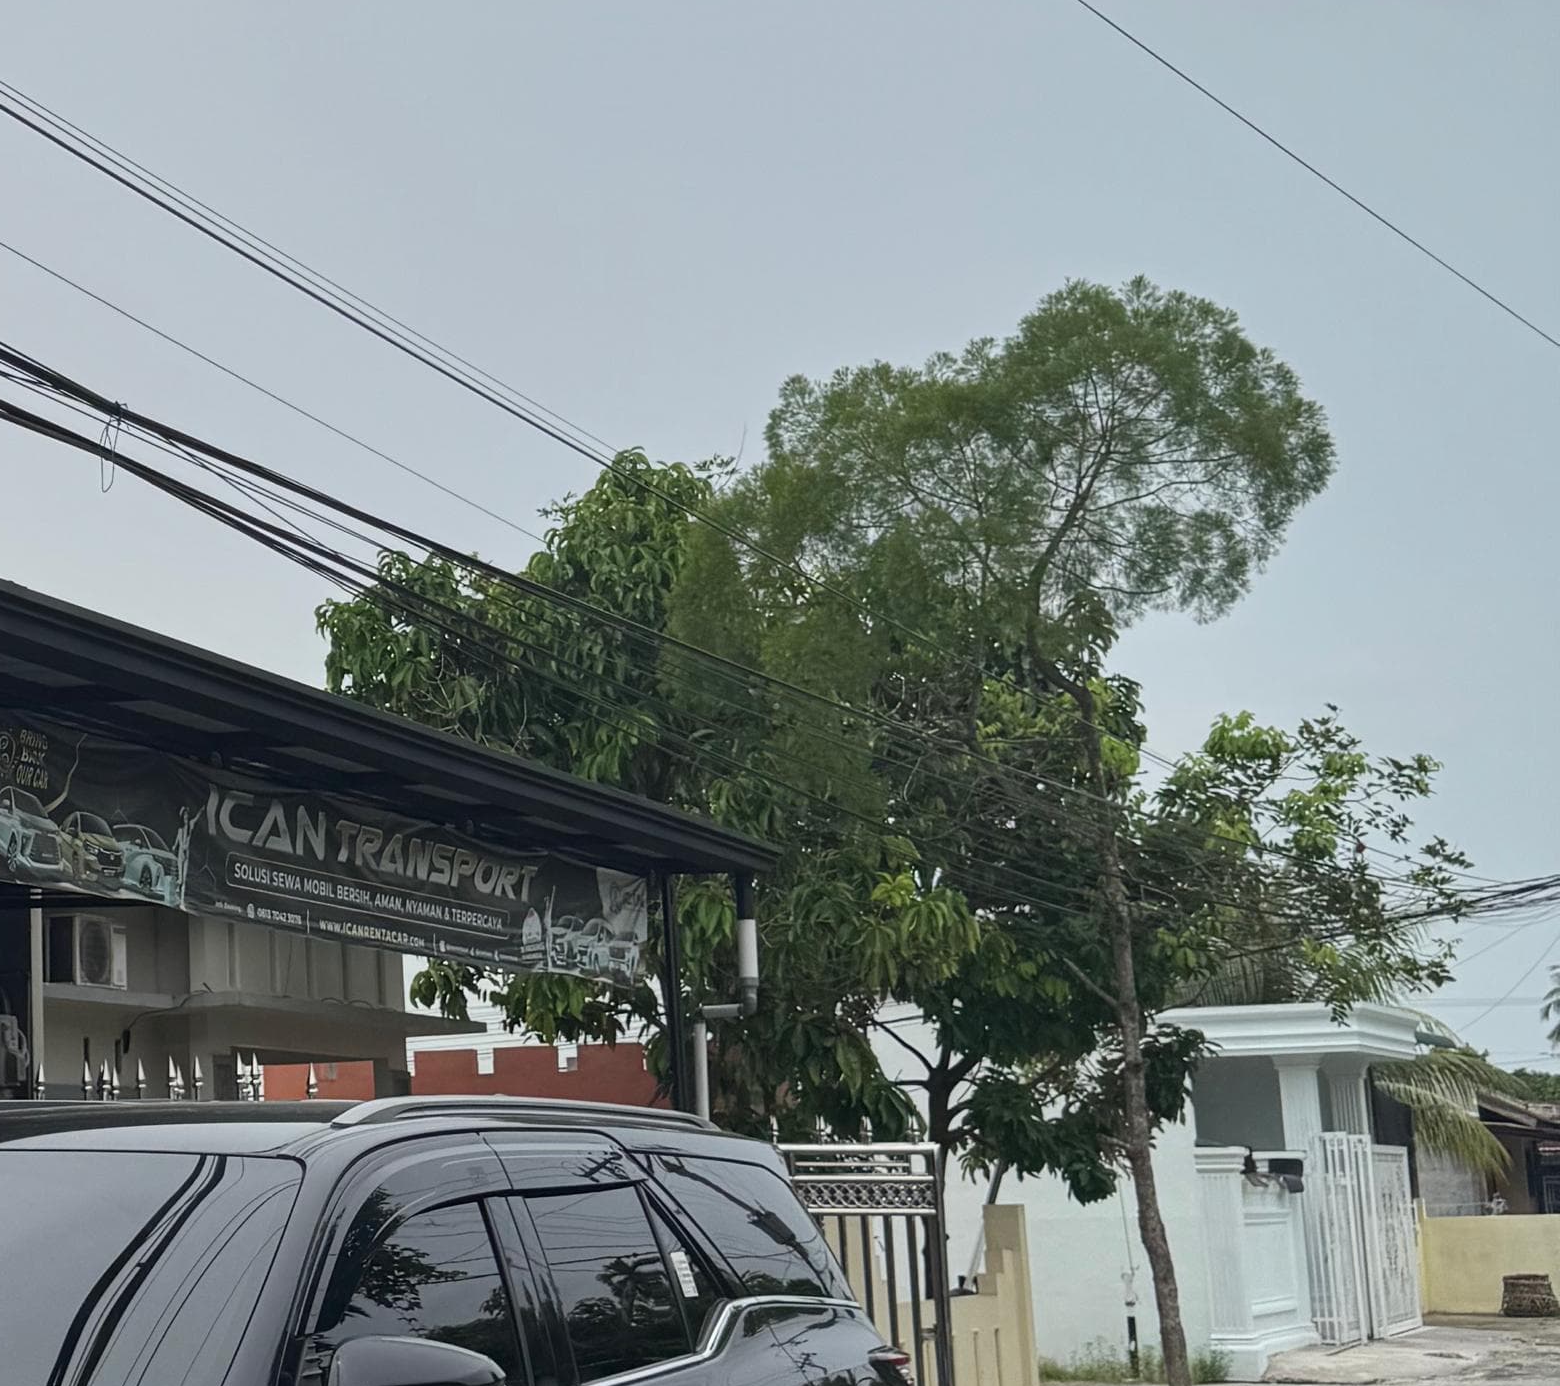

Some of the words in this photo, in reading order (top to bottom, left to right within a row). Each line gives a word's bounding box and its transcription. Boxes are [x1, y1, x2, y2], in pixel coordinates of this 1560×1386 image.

[207, 783, 327, 861] ICAN
[336, 820, 539, 902] TRANSPORT
[234, 863, 270, 885] SOLUSI
[273, 871, 302, 891] SEWA
[303, 878, 335, 898] MOBIL
[336, 885, 373, 906] BERSIH,
[374, 892, 404, 913] AMAN,
[405, 899, 442, 920] NYAMAN
